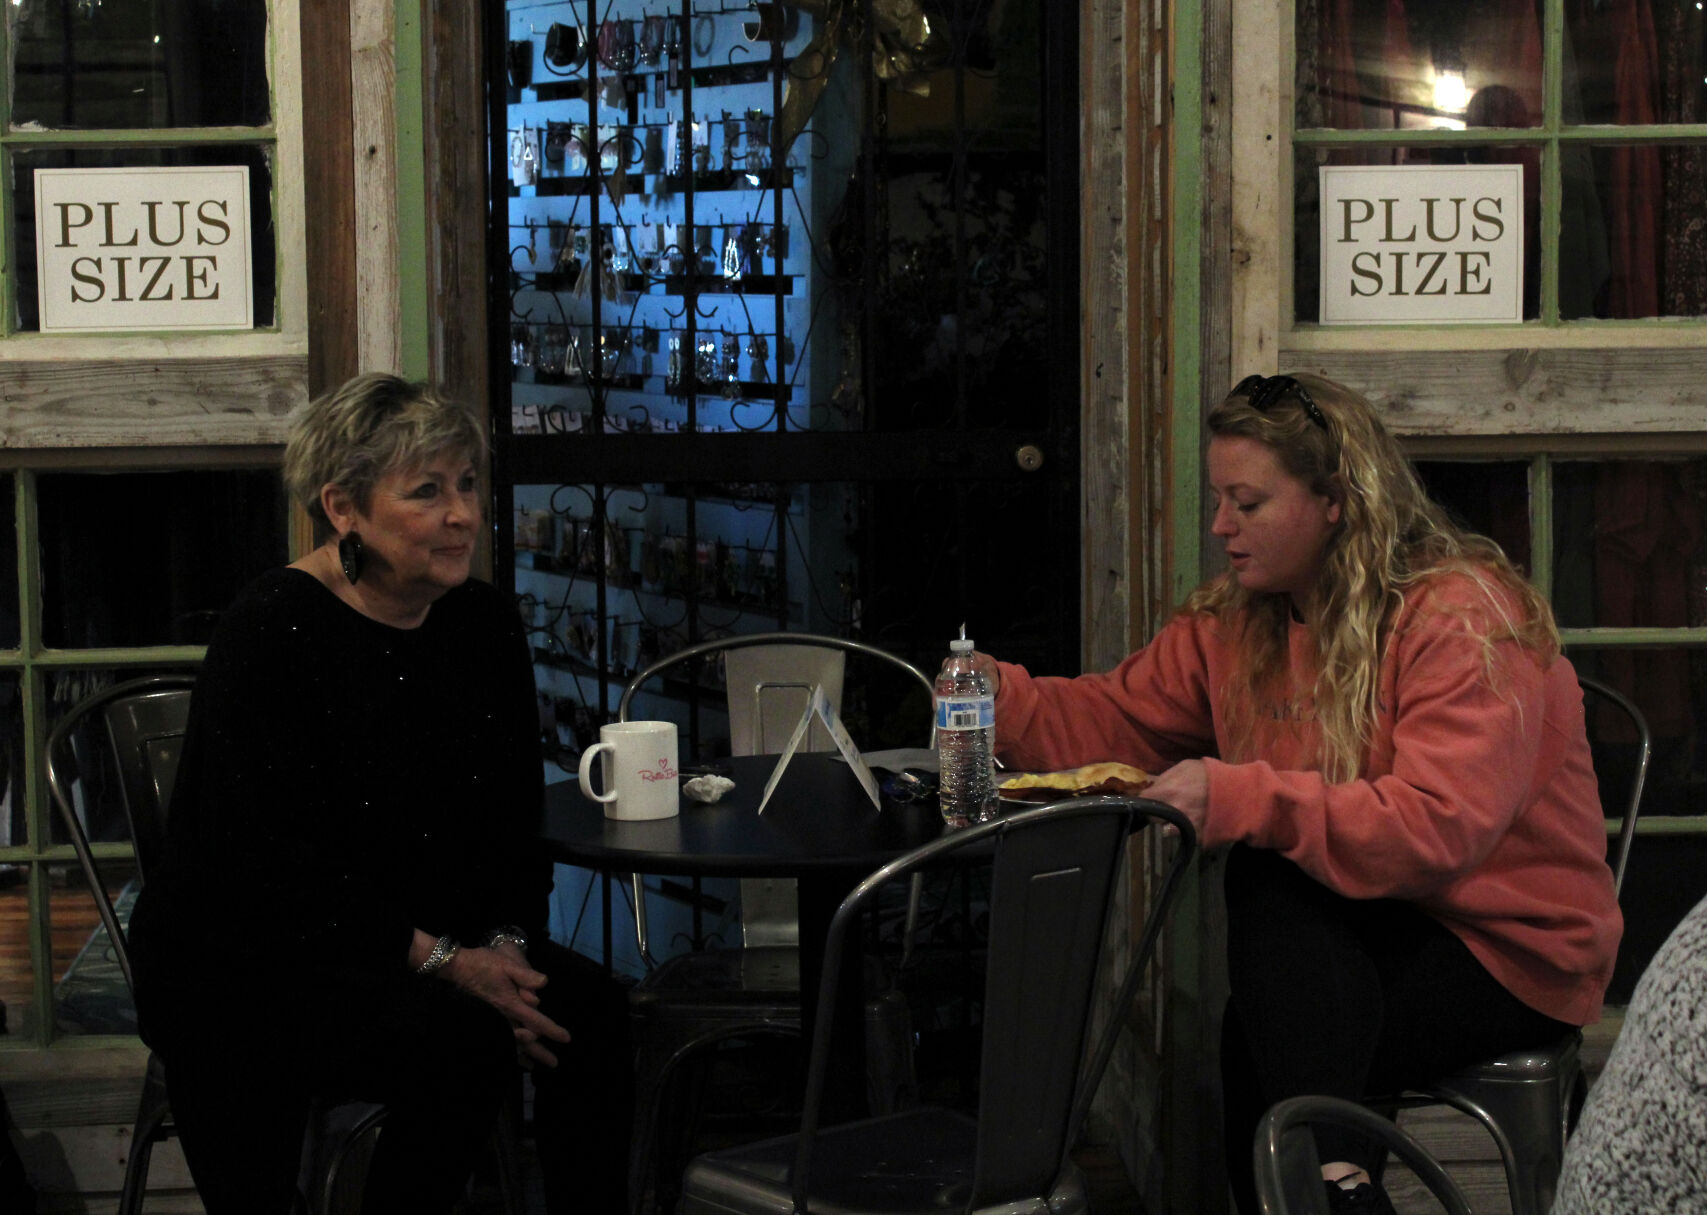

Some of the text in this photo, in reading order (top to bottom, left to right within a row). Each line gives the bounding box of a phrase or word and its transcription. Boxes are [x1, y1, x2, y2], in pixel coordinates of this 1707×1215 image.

[53, 200, 230, 248] PLUS
[1337, 197, 1505, 243] PLUS
[71, 255, 220, 303] SIZE
[1350, 251, 1491, 297] SIZE
